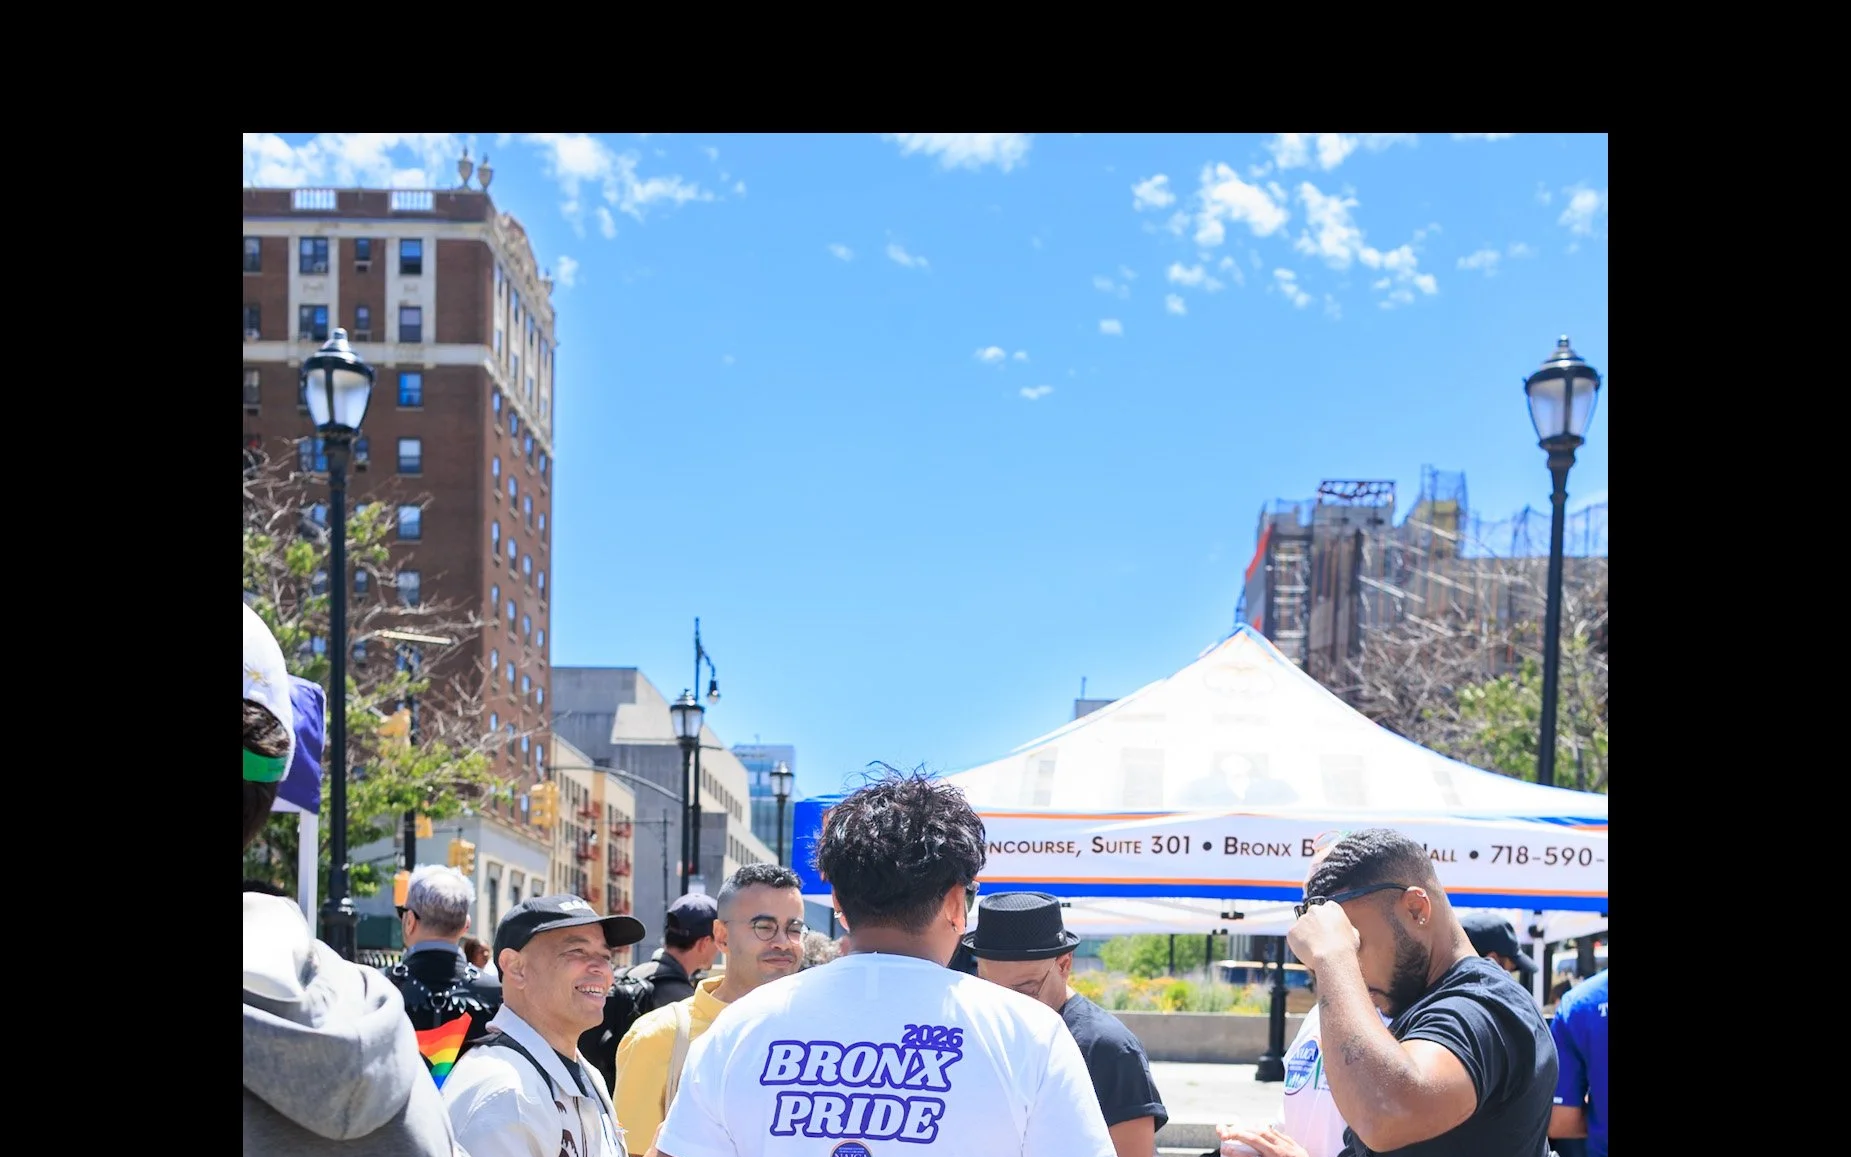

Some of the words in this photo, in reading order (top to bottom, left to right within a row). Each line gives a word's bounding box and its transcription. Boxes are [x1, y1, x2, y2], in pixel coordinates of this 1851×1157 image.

[985, 840, 1082, 858] NCOURSE,
[1151, 836, 1190, 855] 301
[1423, 843, 1458, 863] ALL
[901, 1024, 964, 1049] 2026
[760, 1040, 963, 1093] BRONX
[770, 1090, 946, 1144] PRIDE
